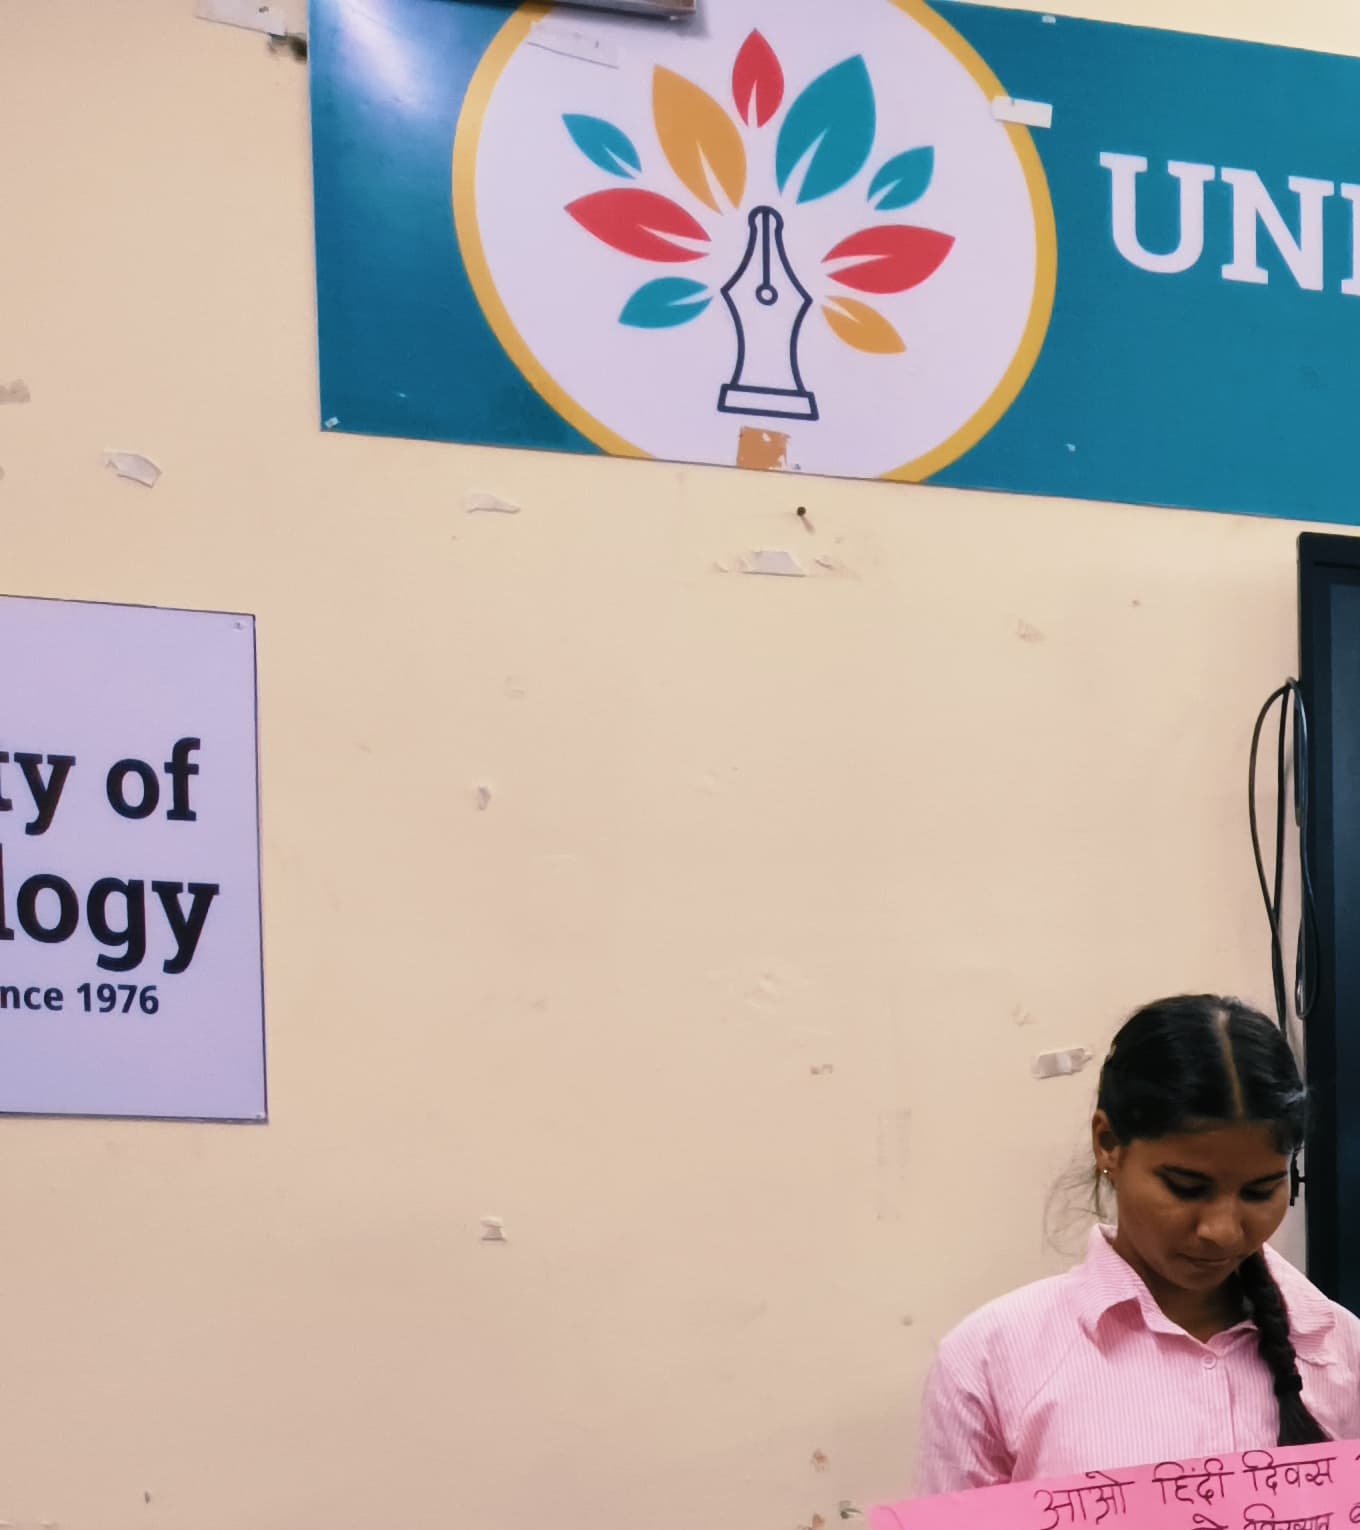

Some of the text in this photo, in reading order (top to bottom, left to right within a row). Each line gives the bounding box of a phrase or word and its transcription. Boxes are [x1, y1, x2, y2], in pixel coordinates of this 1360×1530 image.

[106, 737, 201, 821] of
[76, 982, 160, 1015] 1976
[1151, 1461, 1235, 1505] हिंदी
[1242, 1450, 1338, 1496] दिवस
